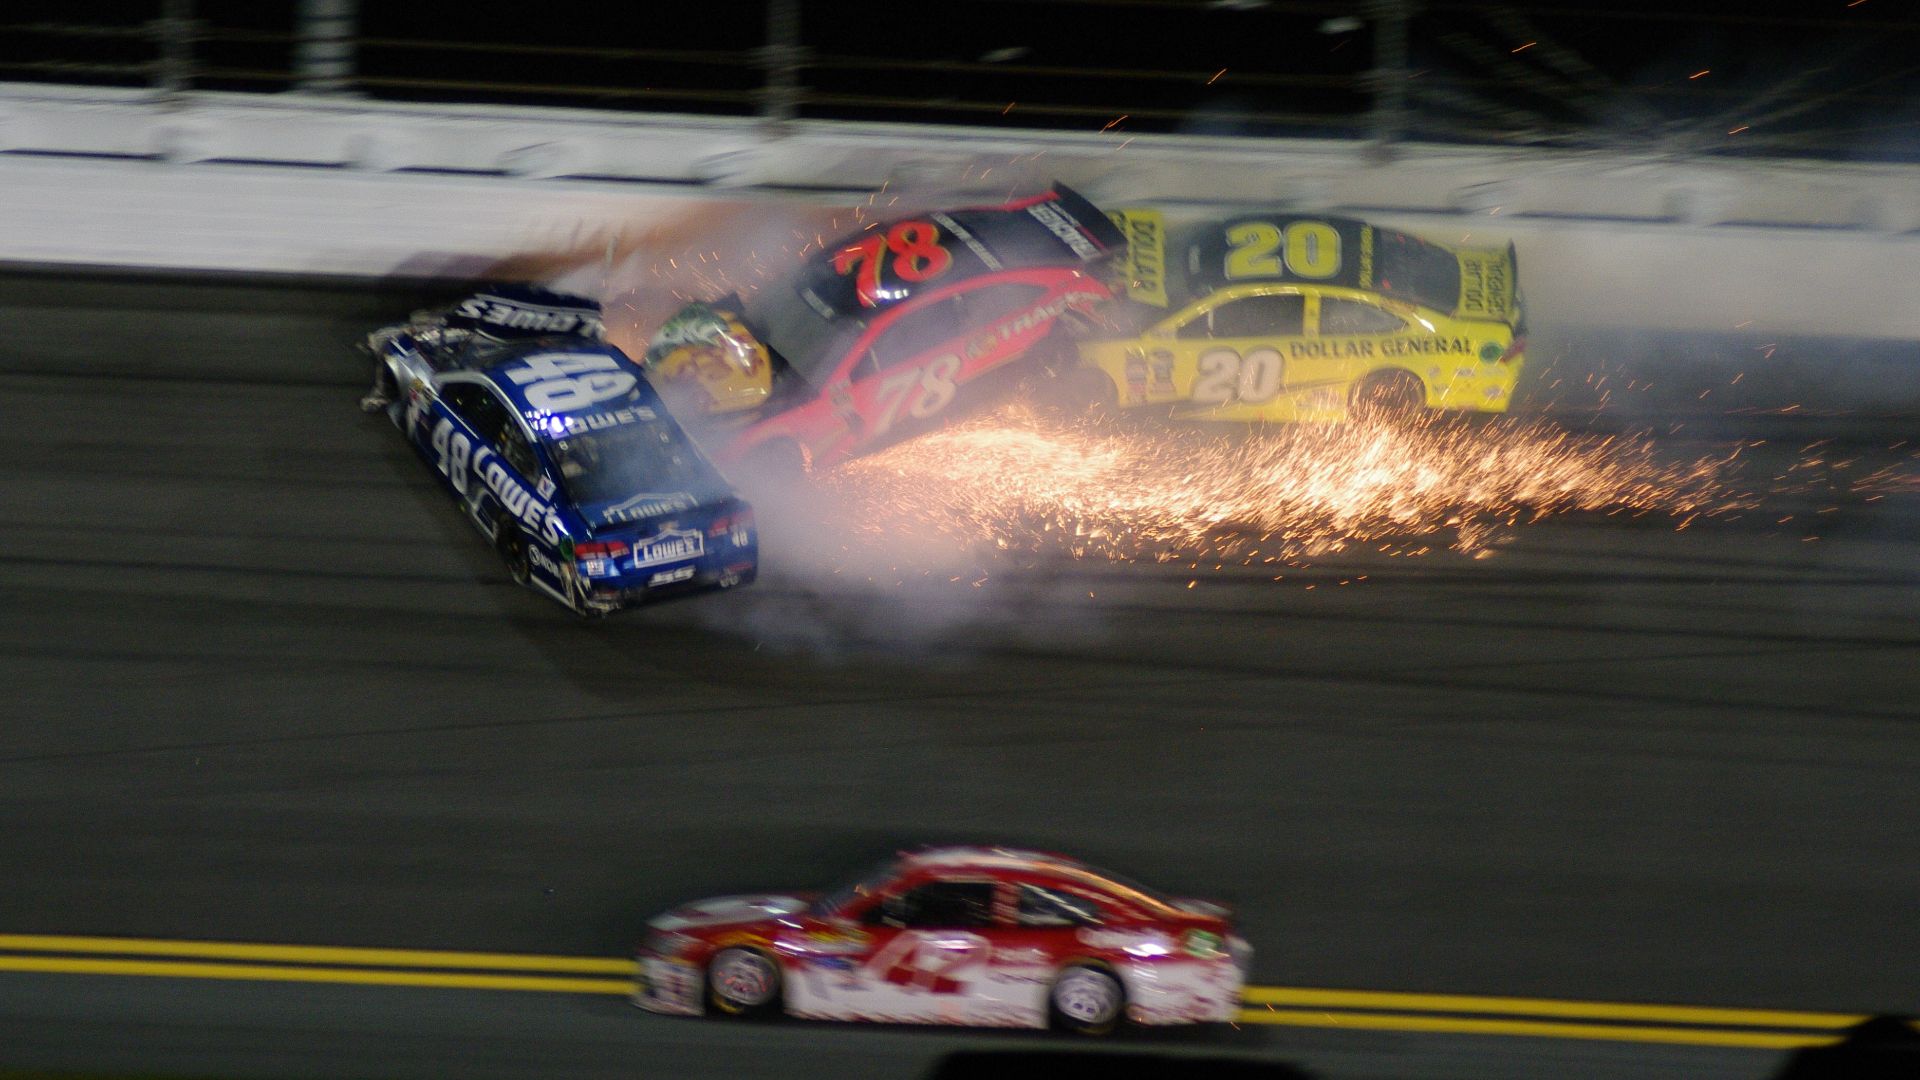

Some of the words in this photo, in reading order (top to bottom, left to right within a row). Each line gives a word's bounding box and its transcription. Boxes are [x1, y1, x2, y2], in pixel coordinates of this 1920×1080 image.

[832, 220, 951, 308] 78
[1224, 221, 1342, 280] 20
[1191, 346, 1284, 401] 20
[1290, 339, 1374, 359] DOLLAR
[1381, 336, 1475, 356] GENERAL
[504, 352, 641, 413] 48
[874, 353, 961, 436] 78
[432, 417, 471, 495] 48
[473, 445, 568, 546] LOWE'S
